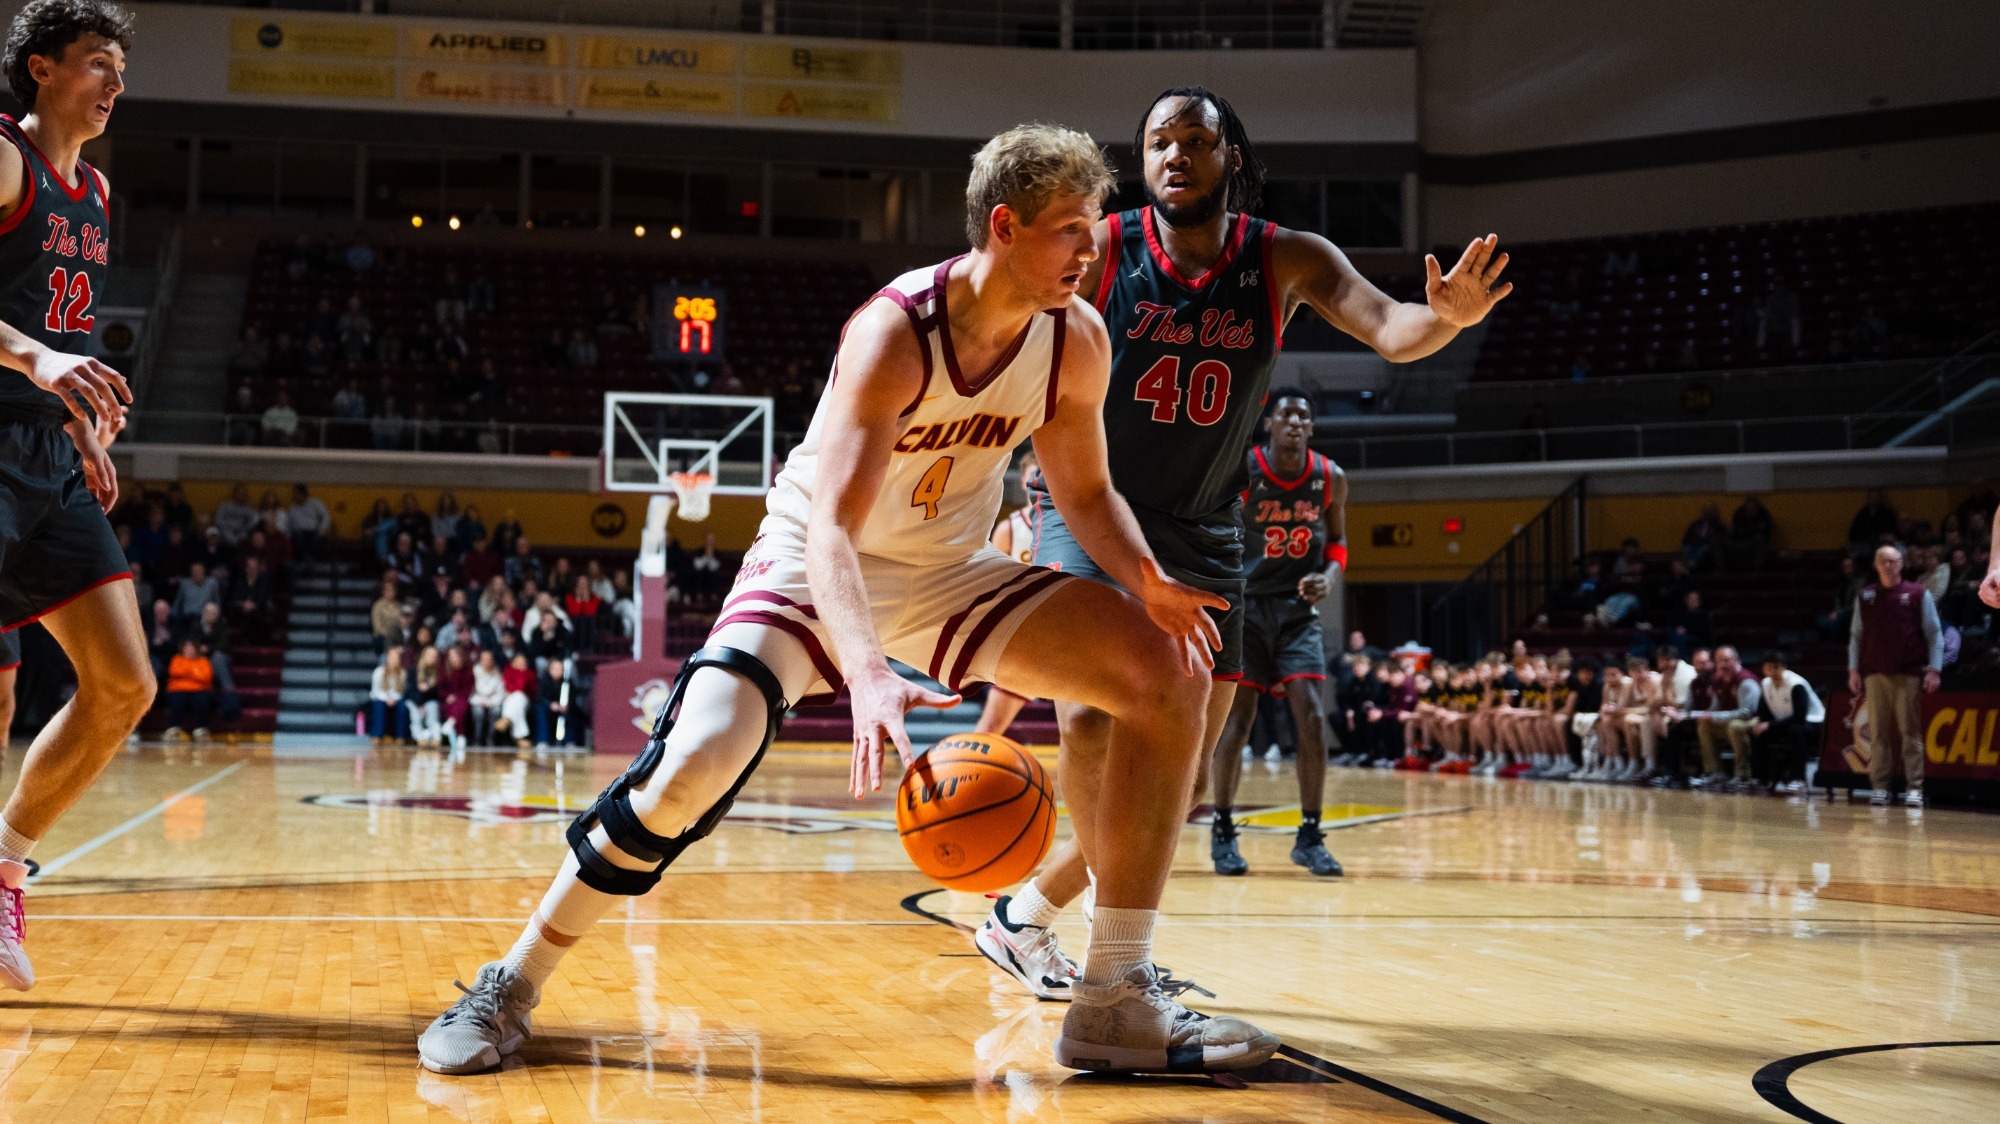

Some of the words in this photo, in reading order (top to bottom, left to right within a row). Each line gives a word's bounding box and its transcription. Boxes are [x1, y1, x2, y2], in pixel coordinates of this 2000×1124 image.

[429, 32, 546, 52] APPLIED
[42, 212, 78, 257] The
[45, 266, 95, 334] 12
[1127, 301, 1194, 344] The
[1200, 308, 1254, 349] Vet
[1134, 355, 1231, 426] 40
[892, 411, 1026, 454] CALVIN
[911, 456, 955, 520] 4
[1255, 500, 1292, 523] The
[1264, 525, 1313, 559] 23
[1925, 707, 2000, 766] CAL
